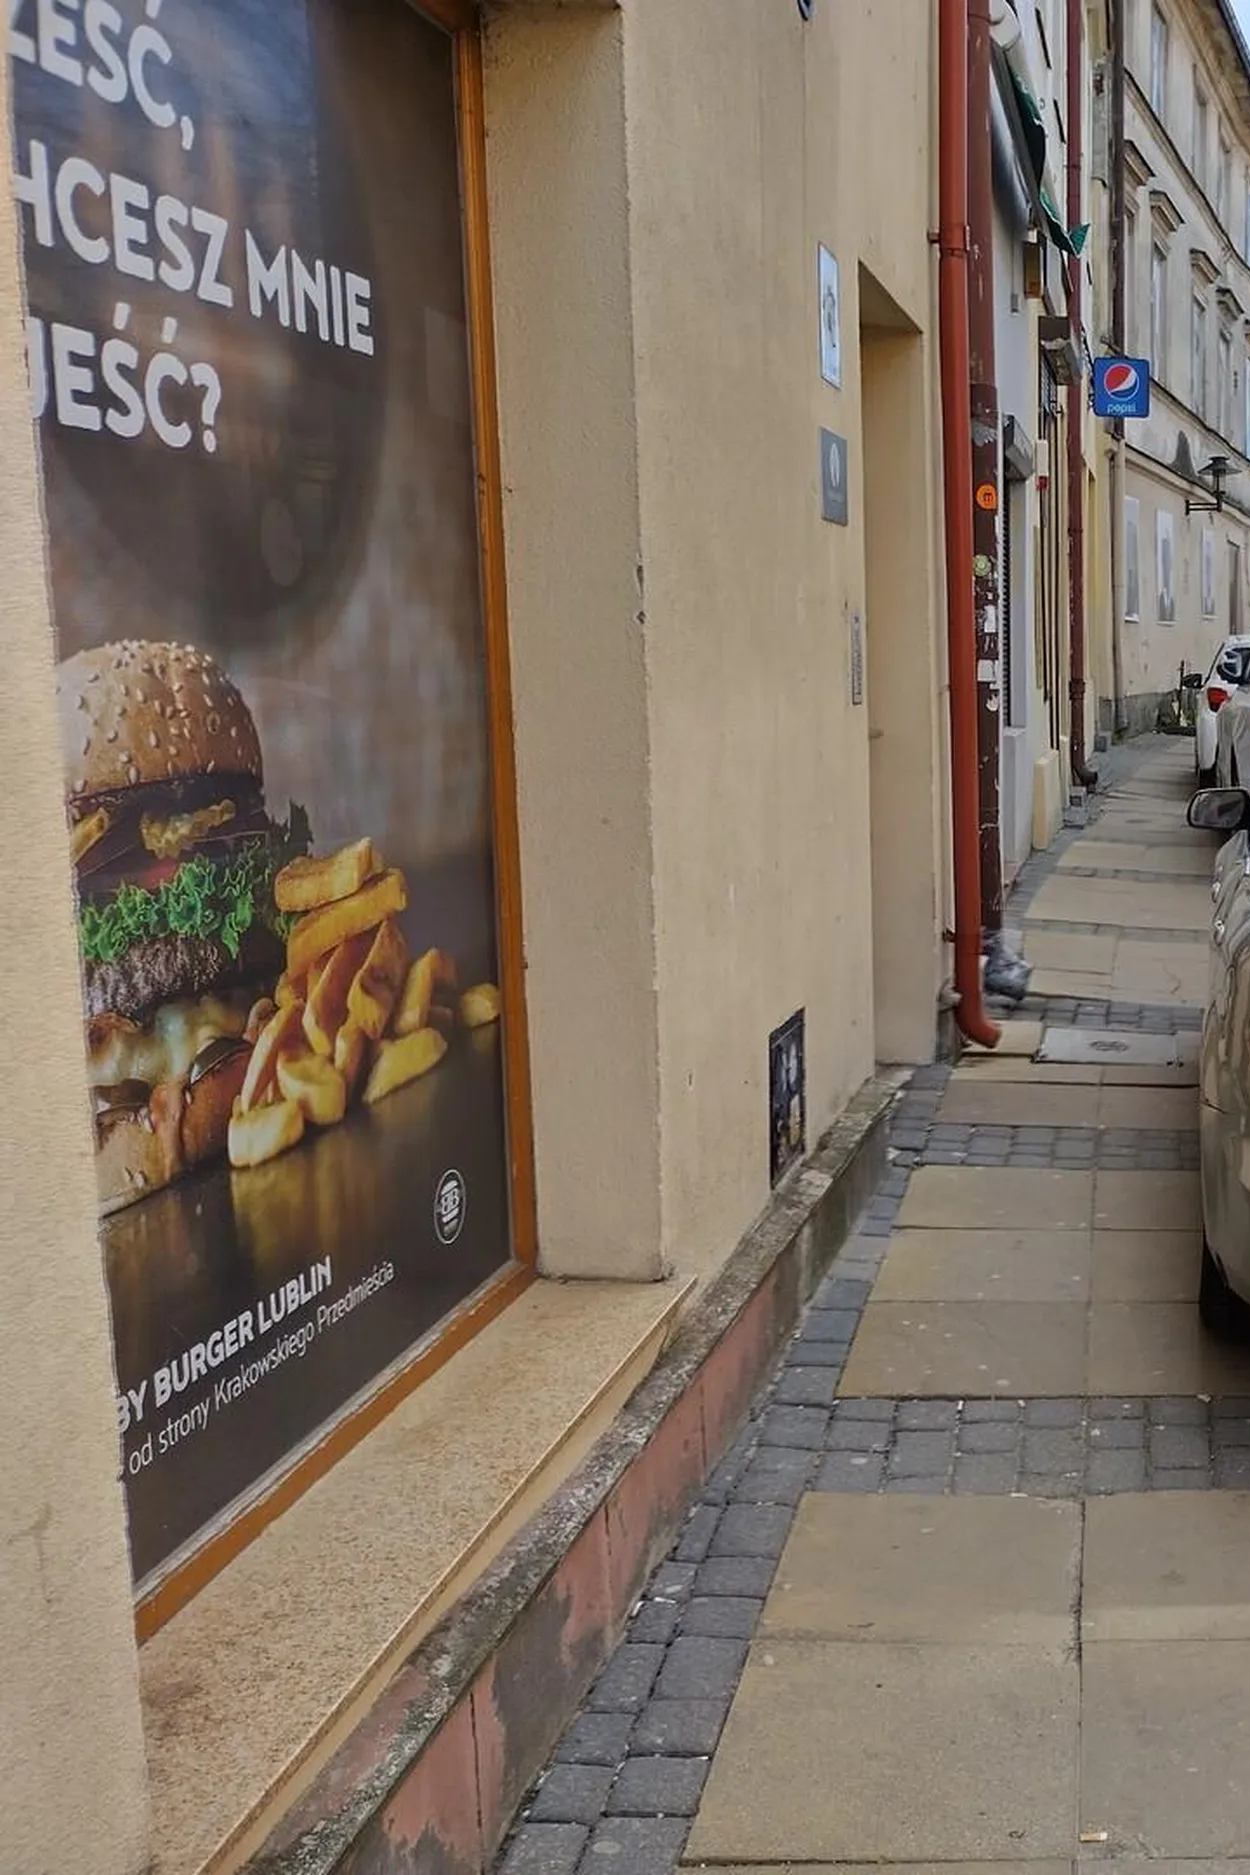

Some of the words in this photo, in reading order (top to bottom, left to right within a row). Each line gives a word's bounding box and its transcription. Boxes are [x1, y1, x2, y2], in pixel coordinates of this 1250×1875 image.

[245, 228, 374, 357] MNIE
[1107, 402, 1136, 415] pepsi
[129, 1433, 153, 1475] od
[158, 1397, 211, 1453] strony
[214, 1322, 314, 1411] Krakowskiego
[316, 1261, 395, 1333] Przedmieścia
[153, 1310, 254, 1407] BURGER
[257, 1255, 333, 1334] LUBLIN
